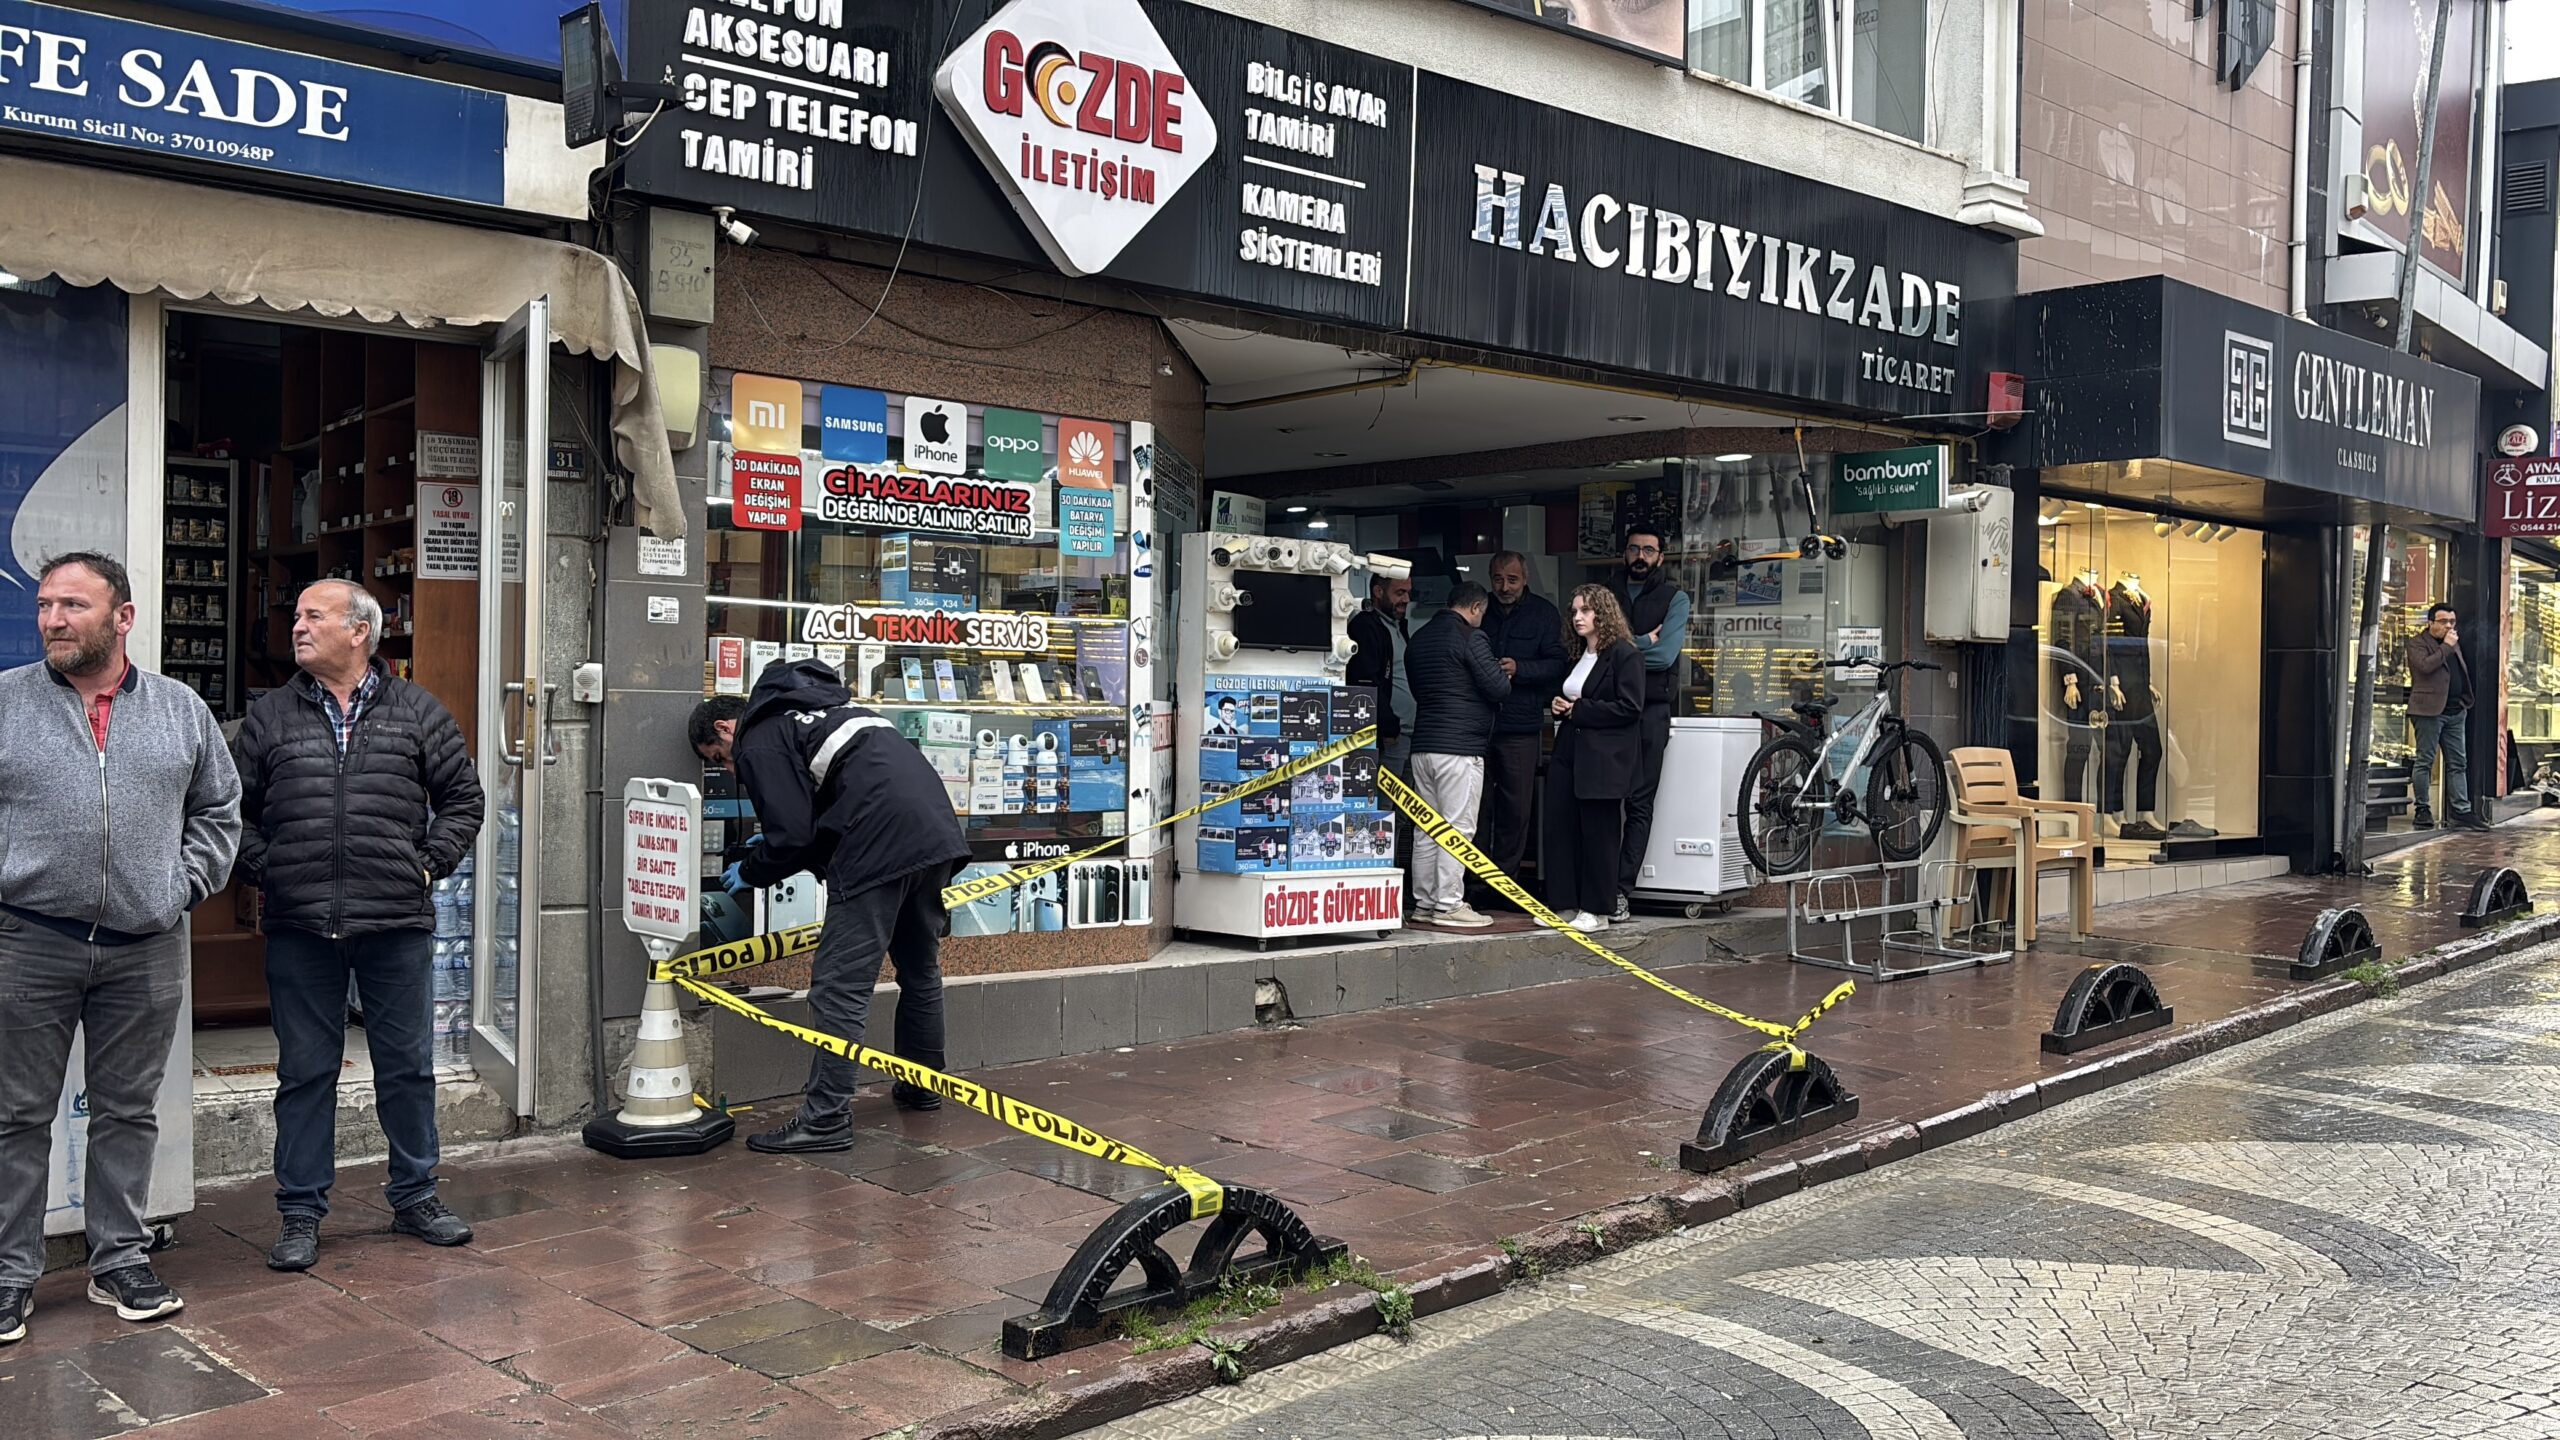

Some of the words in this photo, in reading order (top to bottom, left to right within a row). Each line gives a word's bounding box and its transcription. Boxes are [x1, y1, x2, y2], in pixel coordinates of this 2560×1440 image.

[683, 7, 889, 88] AKSESUARI
[118, 48, 350, 142] SADE
[683, 72, 757, 120] CEP
[766, 90, 917, 157] TELEFON
[3, 105, 78, 131] Kurum
[82, 118, 126, 139] Sicil
[131, 126, 165, 146] No:
[170, 133, 275, 163] 37010948P
[1245, 107, 1336, 159] TAMİRİ
[681, 127, 814, 190] TAMİRİ
[1021, 132, 1156, 205] İLETİŞİM
[1242, 183, 1347, 235] KAMERA
[1240, 228, 1383, 287] SİSTEMLERİ
[1470, 162, 1961, 348] HACIBIYIKZADE
[1860, 347, 1957, 396] TİCARET
[2294, 349, 2435, 450] GENTLEMAN
[824, 415, 884, 436] SAMSUNG
[556, 451, 575, 468] 31
[913, 443, 959, 465] iPhone
[2337, 447, 2378, 475] CLASSICS
[734, 459, 747, 471] 30
[750, 459, 800, 476] DAKİKADA
[1068, 467, 1104, 480] HUAWEI
[1843, 458, 1929, 484] bambum
[750, 477, 785, 492] EKRAN
[823, 465, 1030, 513] CİHAZLARINIZ
[744, 492, 790, 510] DEĞİŞİMİ
[1060, 493, 1071, 507] 30
[1073, 493, 1113, 510] DAKİKADA
[746, 511, 787, 526] YAPILIR
[825, 496, 920, 528] DEĞERİNDE
[920, 506, 975, 532] ALINIR
[975, 511, 1031, 536] SATILIR
[1069, 508, 1105, 523] BATARYA
[2520, 523, 2545, 532] 0544
[1068, 522, 1105, 539] DEĞİŞİMİ
[1071, 538, 1104, 553] YAPILIR
[914, 597, 929, 606] 360
[942, 599, 958, 608] X34
[808, 603, 866, 641] ACİL
[873, 609, 960, 644] TEKNİK
[968, 614, 1042, 648] SERVİS
[724, 657, 737, 669] 15
[1072, 759, 1085, 768] 360
[1377, 768, 1434, 826] GİRİLMEZ
[628, 809, 645, 826] SIFIR
[645, 812, 654, 828] VE
[1023, 842, 1071, 858] iPhone
[1445, 834, 1490, 875] POLİS
[649, 858, 676, 877] SAATTE
[628, 877, 686, 901] TABLET&TELEFON
[654, 904, 680, 924] YAPILIR
[1264, 884, 1319, 928] GÖZDE
[1323, 878, 1401, 924] GÜVENLİK
[668, 942, 755, 979] POLİS
